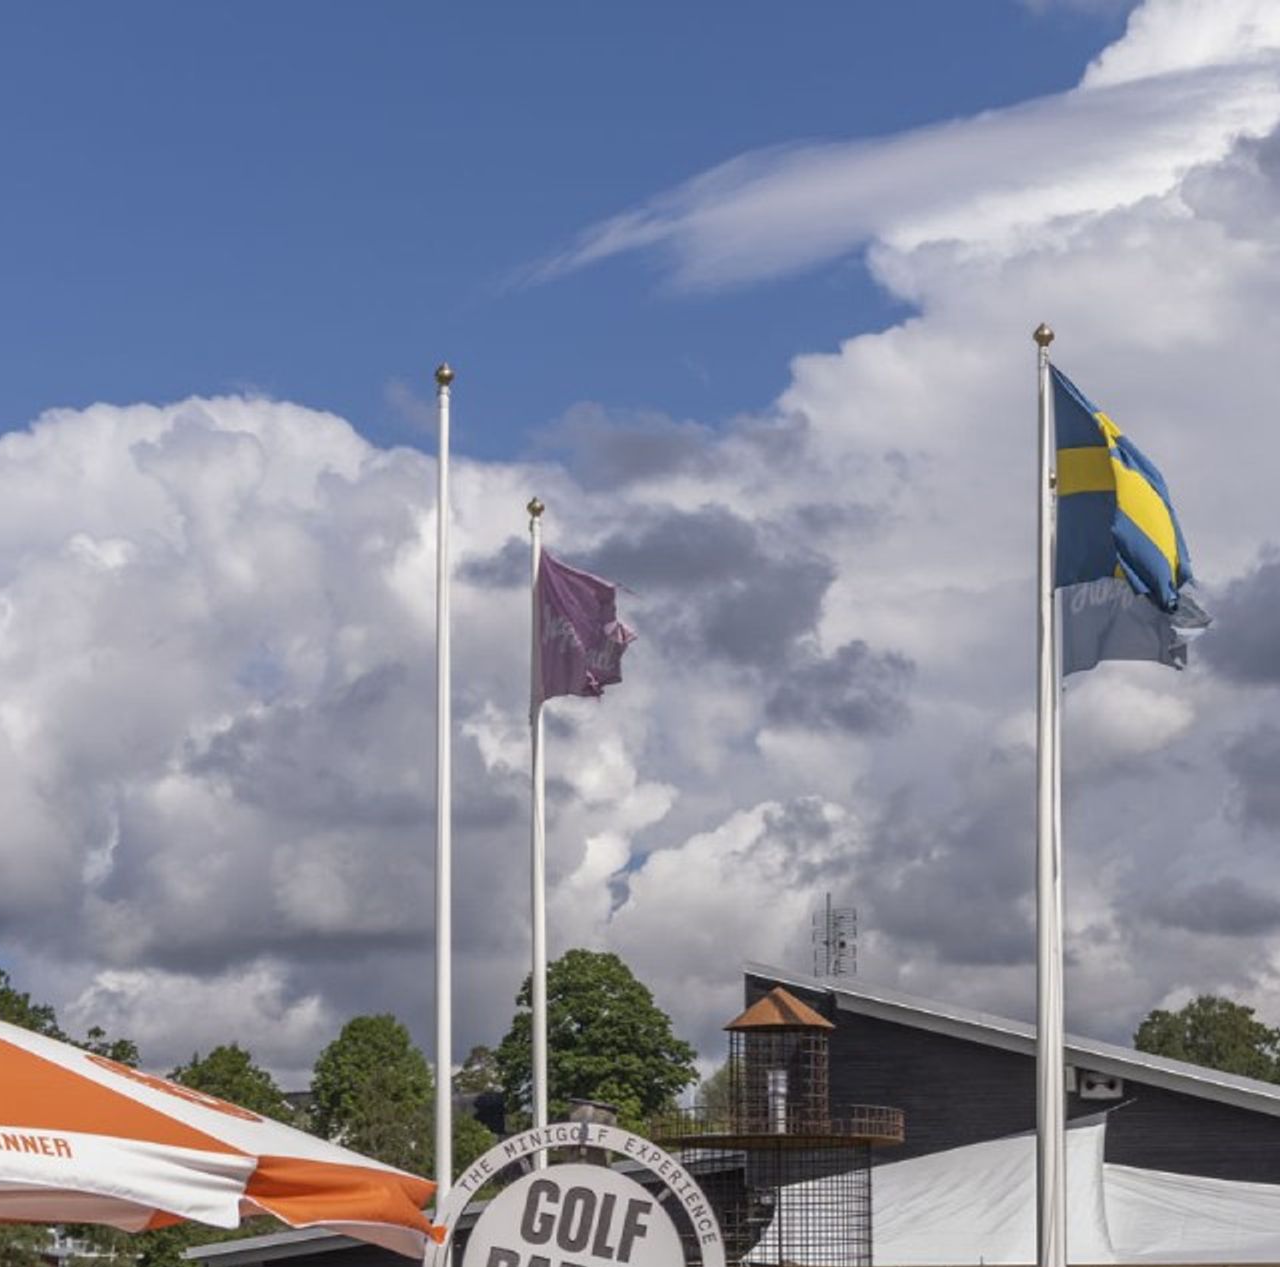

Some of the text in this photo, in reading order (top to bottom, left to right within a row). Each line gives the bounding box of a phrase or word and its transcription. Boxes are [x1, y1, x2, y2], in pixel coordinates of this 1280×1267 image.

[459, 1159, 494, 1193] THE
[624, 1137, 718, 1246] EXPERIENCE
[520, 1178, 653, 1264] GOLF
